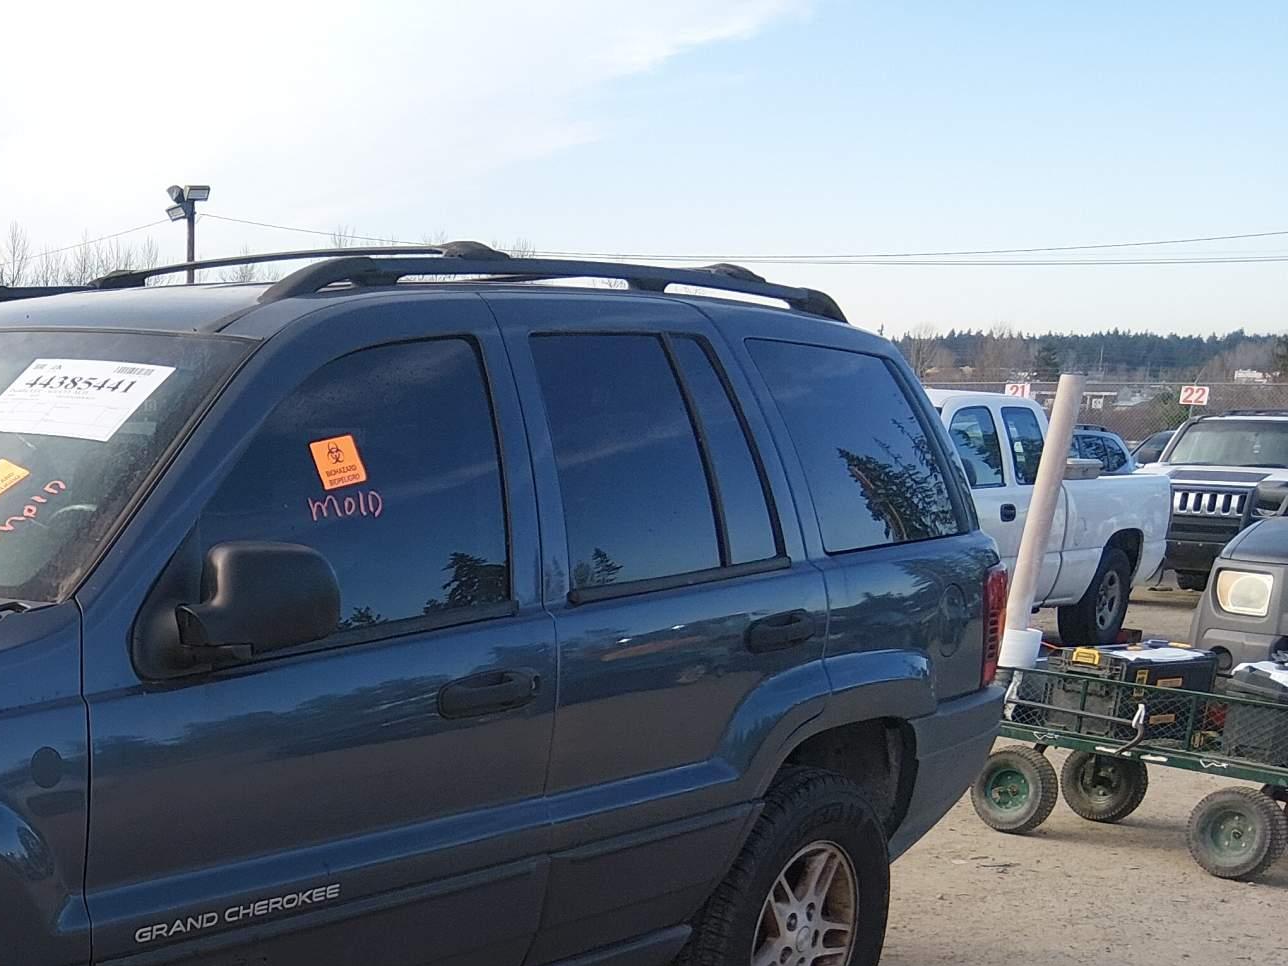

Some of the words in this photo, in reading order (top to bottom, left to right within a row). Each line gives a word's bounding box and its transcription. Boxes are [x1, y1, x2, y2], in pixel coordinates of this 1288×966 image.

[25, 375, 137, 393] 44385441
[1010, 385, 1025, 397] 21
[1182, 387, 1206, 404] 22
[325, 464, 358, 477] BIOHAZARD
[134, 912, 219, 943] GRAND
[224, 883, 341, 922] CHEROKEE
